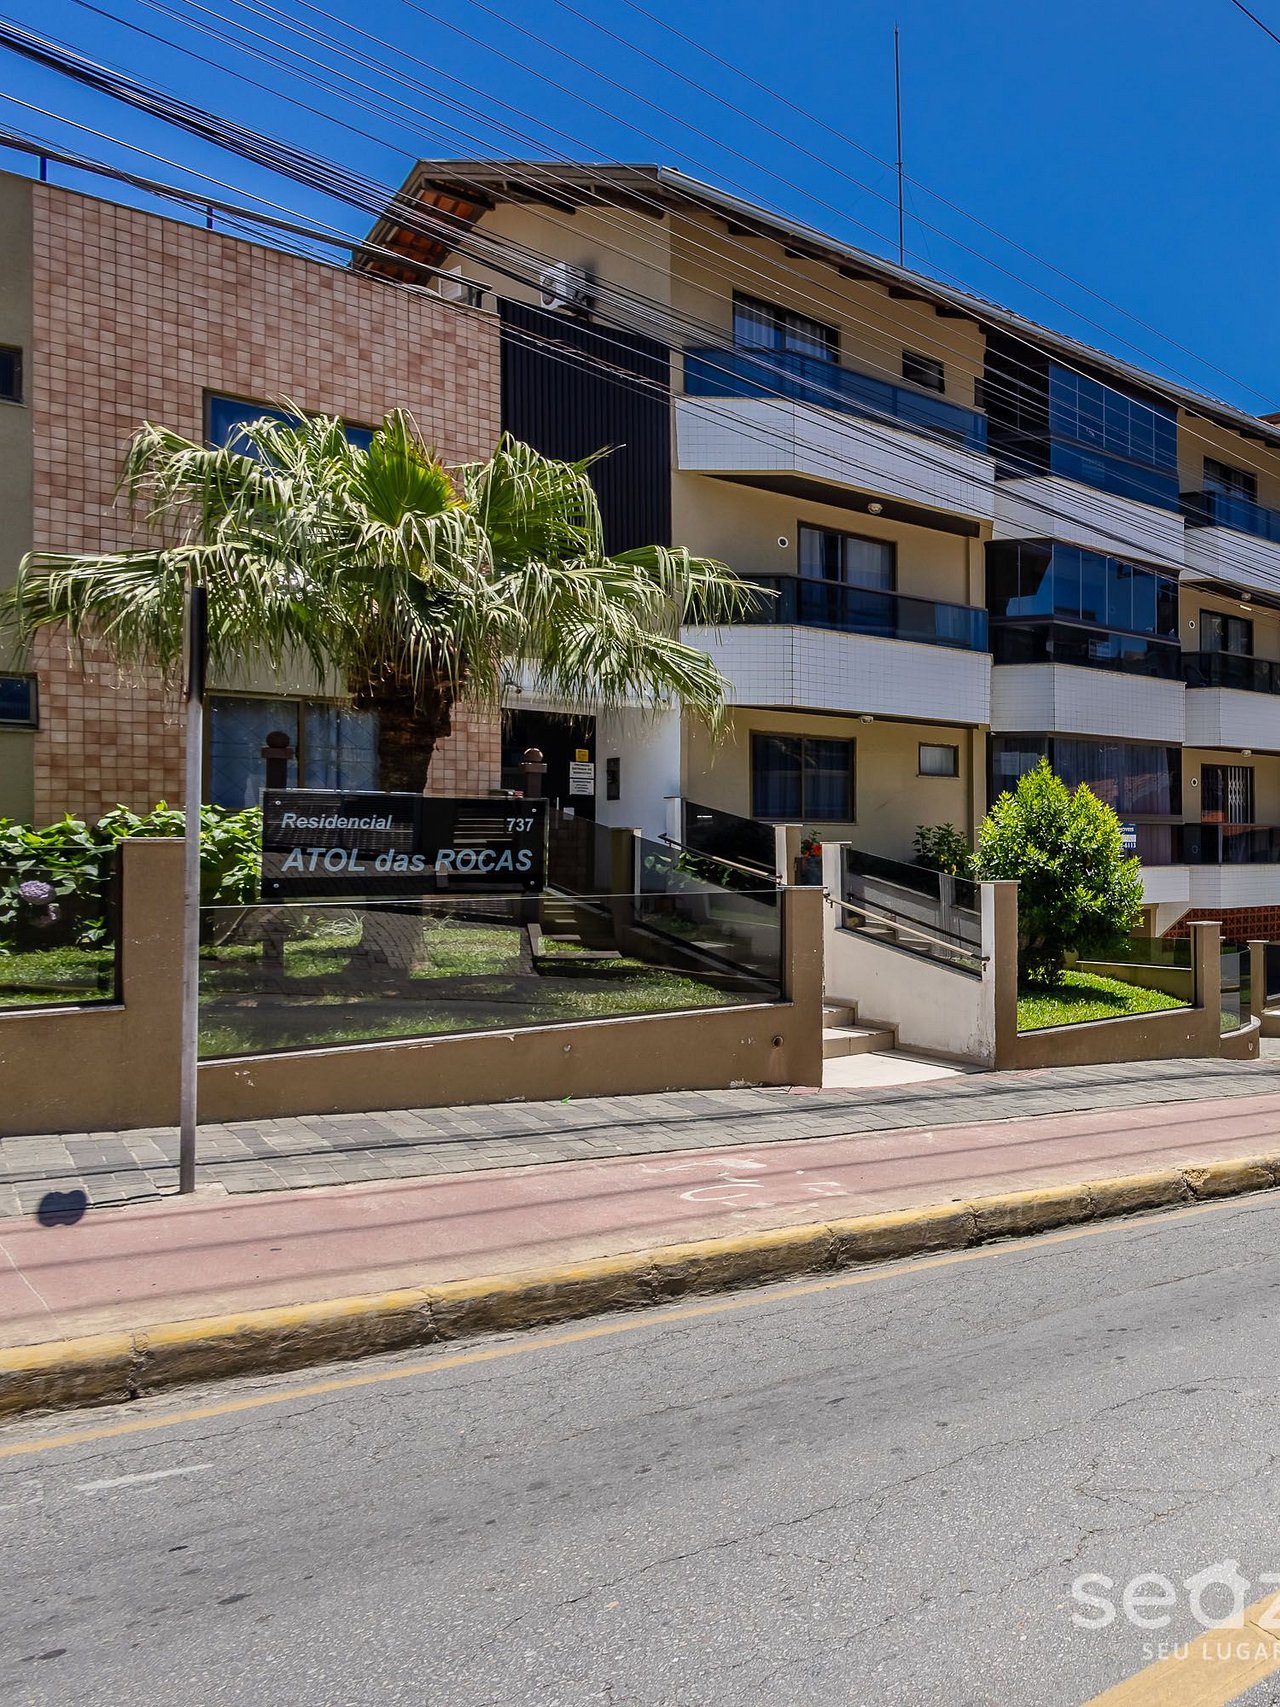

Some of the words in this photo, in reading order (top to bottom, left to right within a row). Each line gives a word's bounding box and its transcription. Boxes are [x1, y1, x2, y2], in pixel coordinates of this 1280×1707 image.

[281, 812, 392, 830] Residencial
[506, 817, 534, 832] 737
[281, 847, 366, 873] ATOL
[374, 848, 426, 873] das
[434, 849, 533, 873] ROCAS
